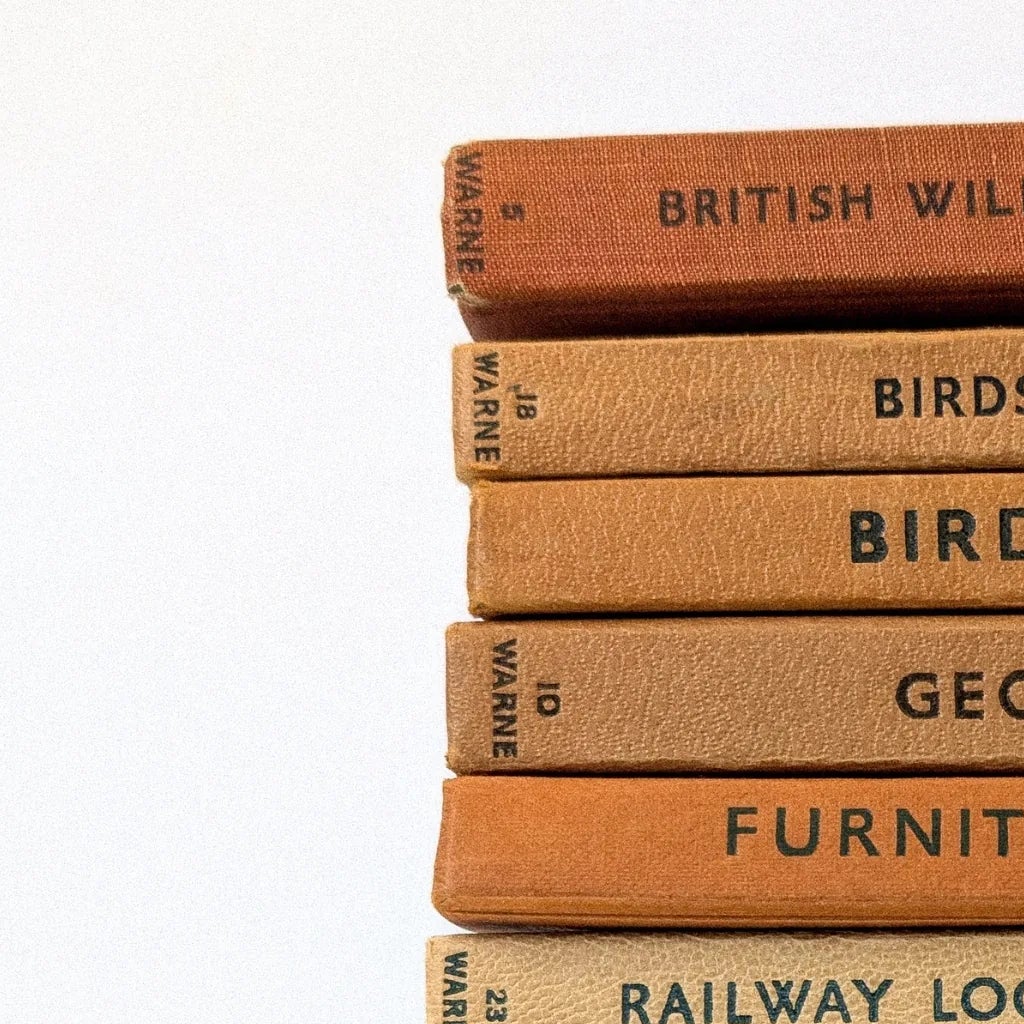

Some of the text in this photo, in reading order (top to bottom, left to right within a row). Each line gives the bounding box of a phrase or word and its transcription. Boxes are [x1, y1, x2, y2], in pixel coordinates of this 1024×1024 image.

[454, 150, 485, 275] WARNE
[501, 203, 524, 222] 5
[659, 183, 874, 228] BRITISH
[473, 350, 500, 463] WARNE
[491, 638, 518, 758] WARNE
[536, 682, 561, 717] 10
[485, 988, 508, 1023] 23
